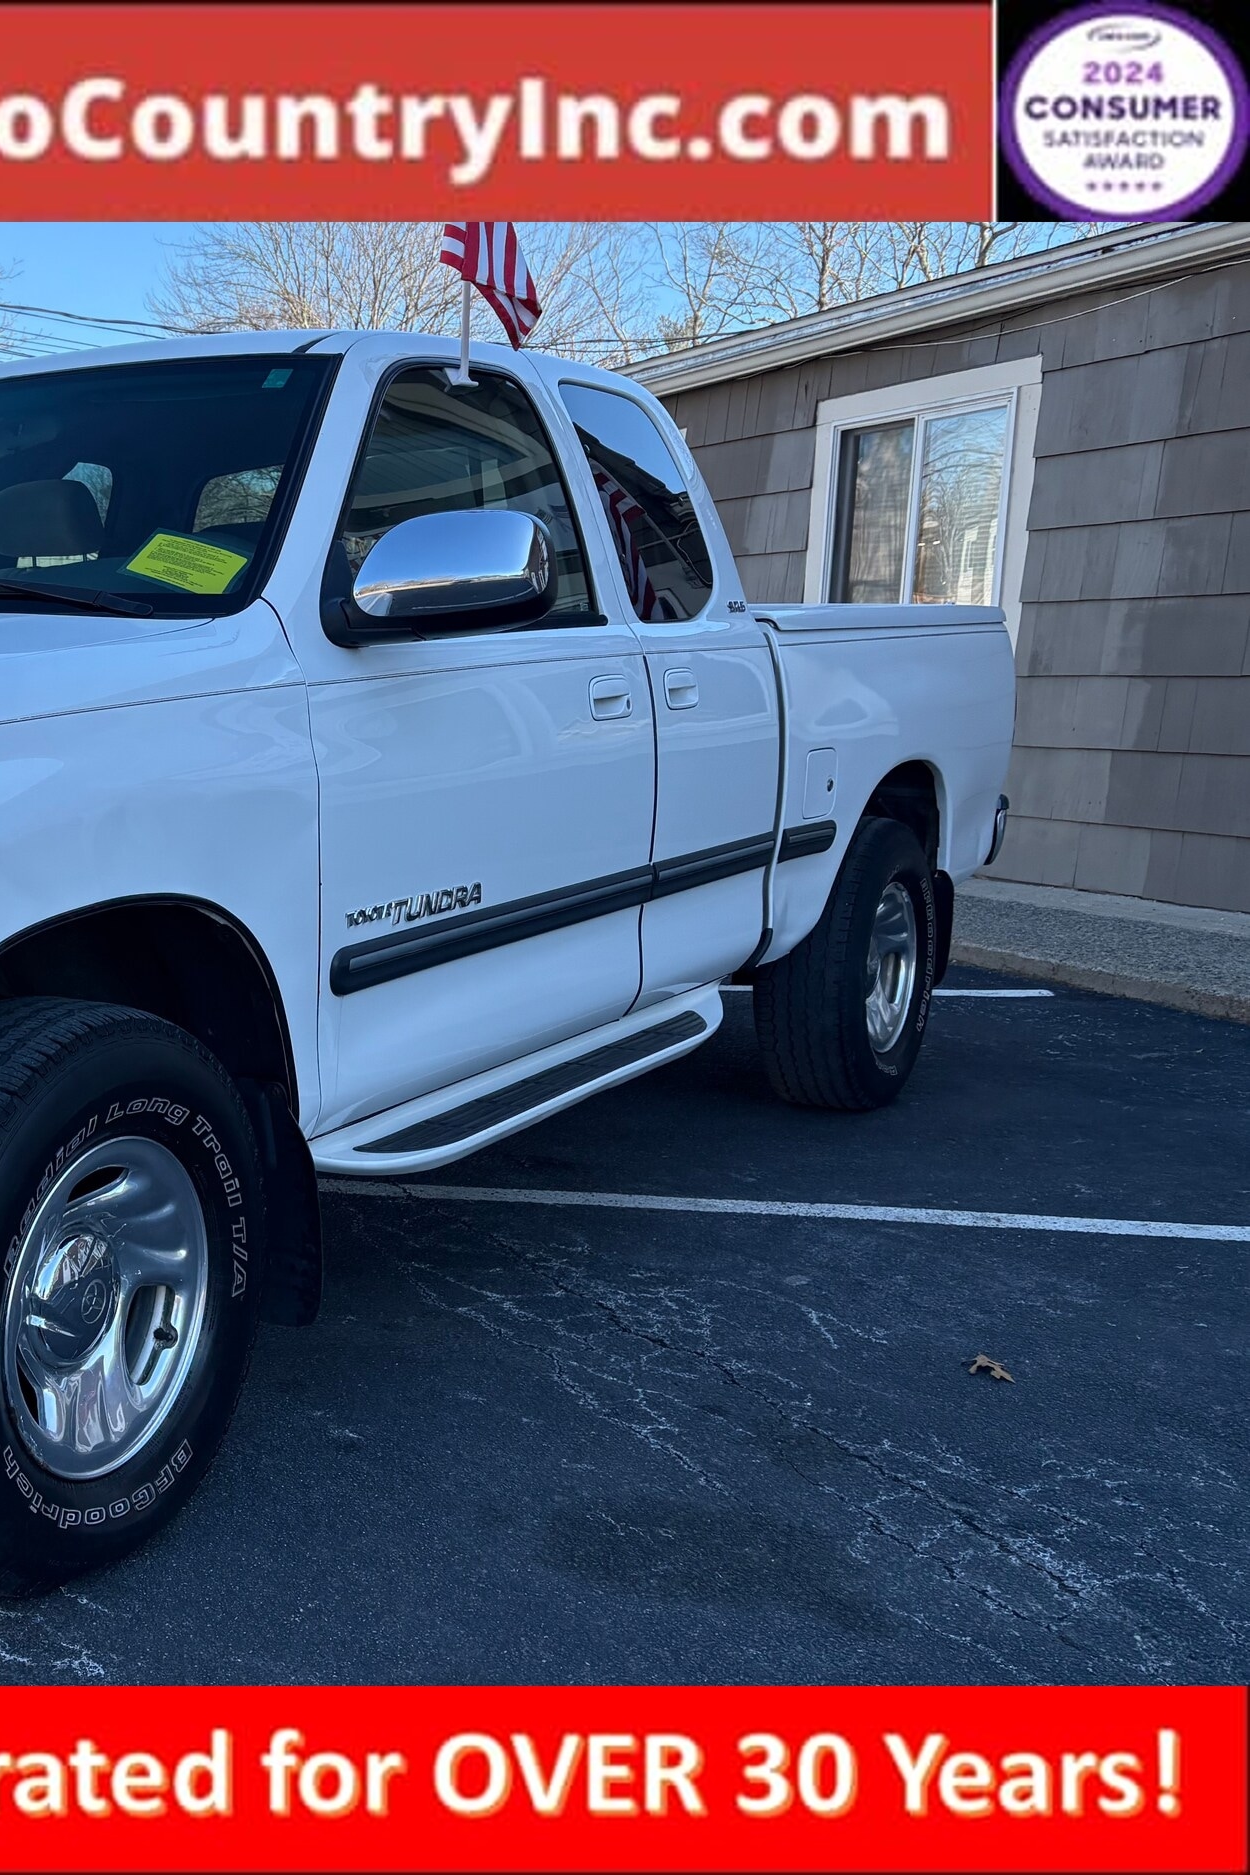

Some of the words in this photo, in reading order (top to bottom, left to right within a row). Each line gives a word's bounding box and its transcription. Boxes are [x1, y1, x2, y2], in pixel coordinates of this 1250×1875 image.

[391, 881, 482, 926] TUNDRA
[3, 1115, 99, 1279] Radial
[105, 1097, 190, 1126] Long
[191, 1114, 244, 1208] Trail
[231, 1216, 249, 1299] T/A
[3, 1438, 195, 1530] BFGoodrich
